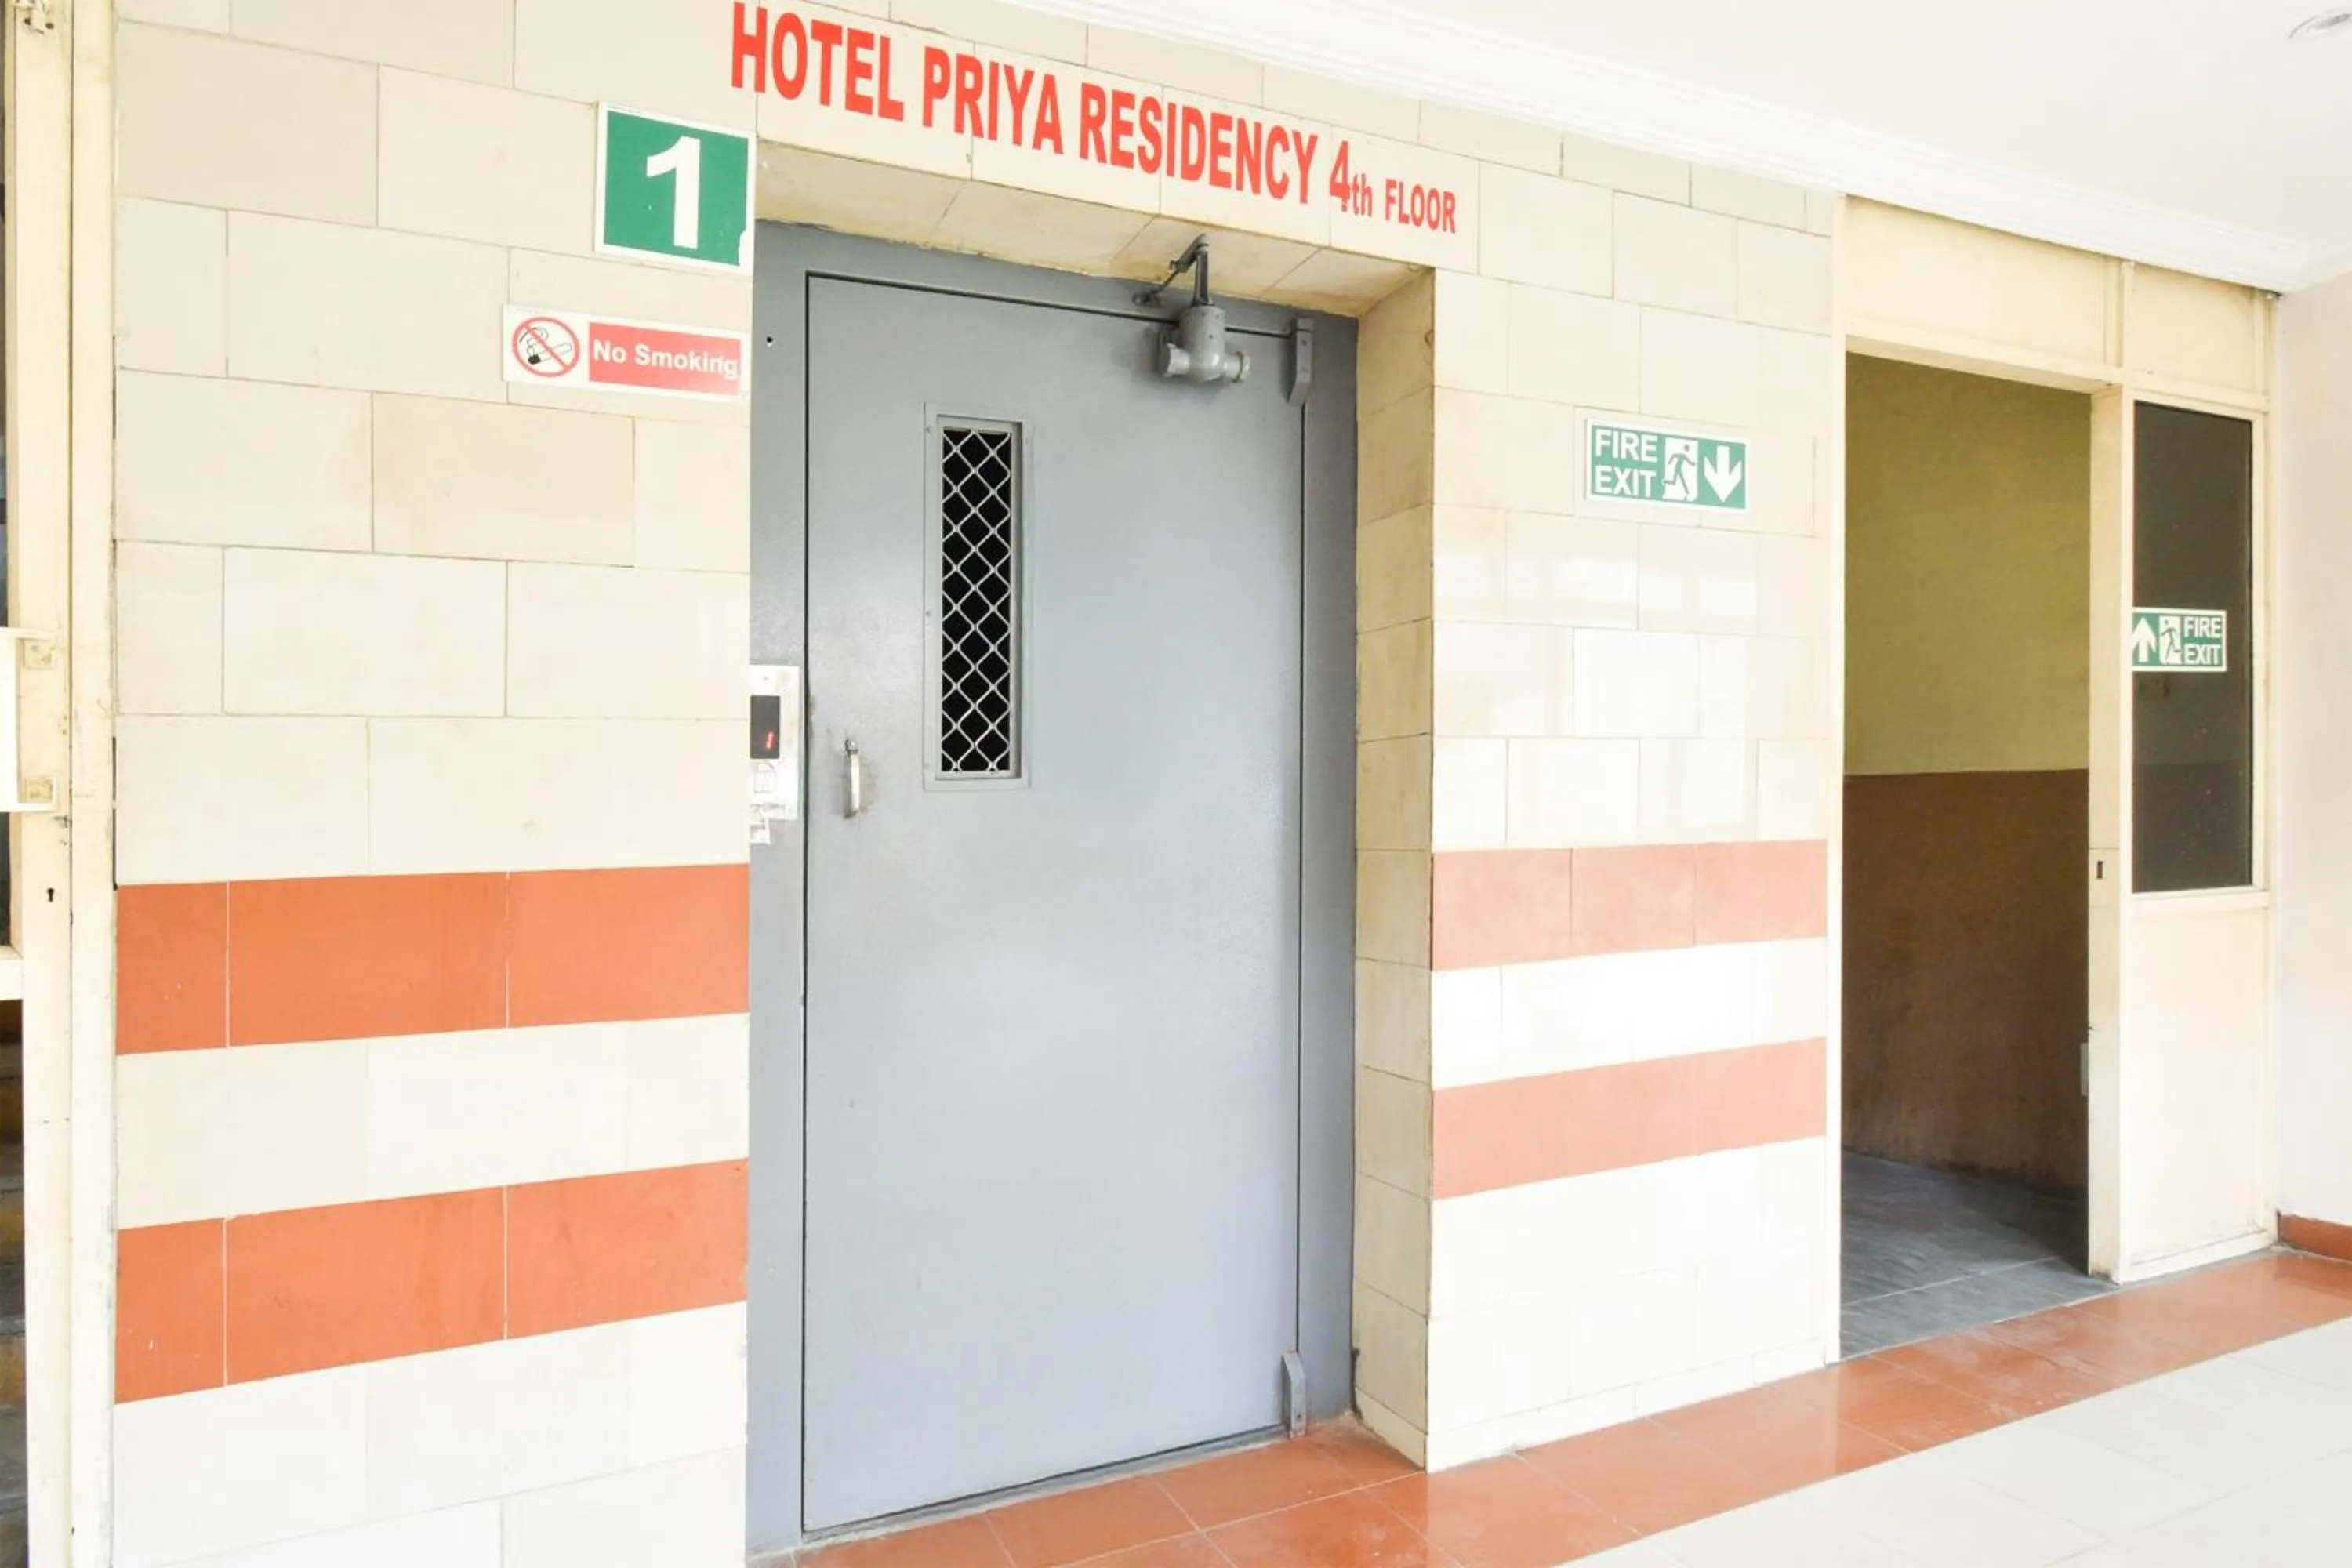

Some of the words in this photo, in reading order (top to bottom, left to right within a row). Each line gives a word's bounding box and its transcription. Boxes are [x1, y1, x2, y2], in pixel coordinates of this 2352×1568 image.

[731, 2, 904, 122] HOTEL
[922, 46, 1063, 154] PRIYA
[1080, 82, 1318, 204] RESIDENCY
[1329, 140, 1373, 217] 4th
[1385, 178, 1456, 233] FLOOR
[646, 136, 701, 249] 1
[593, 339, 626, 363] No
[635, 343, 739, 378] Smoking
[1595, 428, 1658, 463] FIRE
[1595, 464, 1657, 497] EXIT
[2183, 616, 2221, 638] FIRE
[2183, 643, 2220, 665] EXIT
